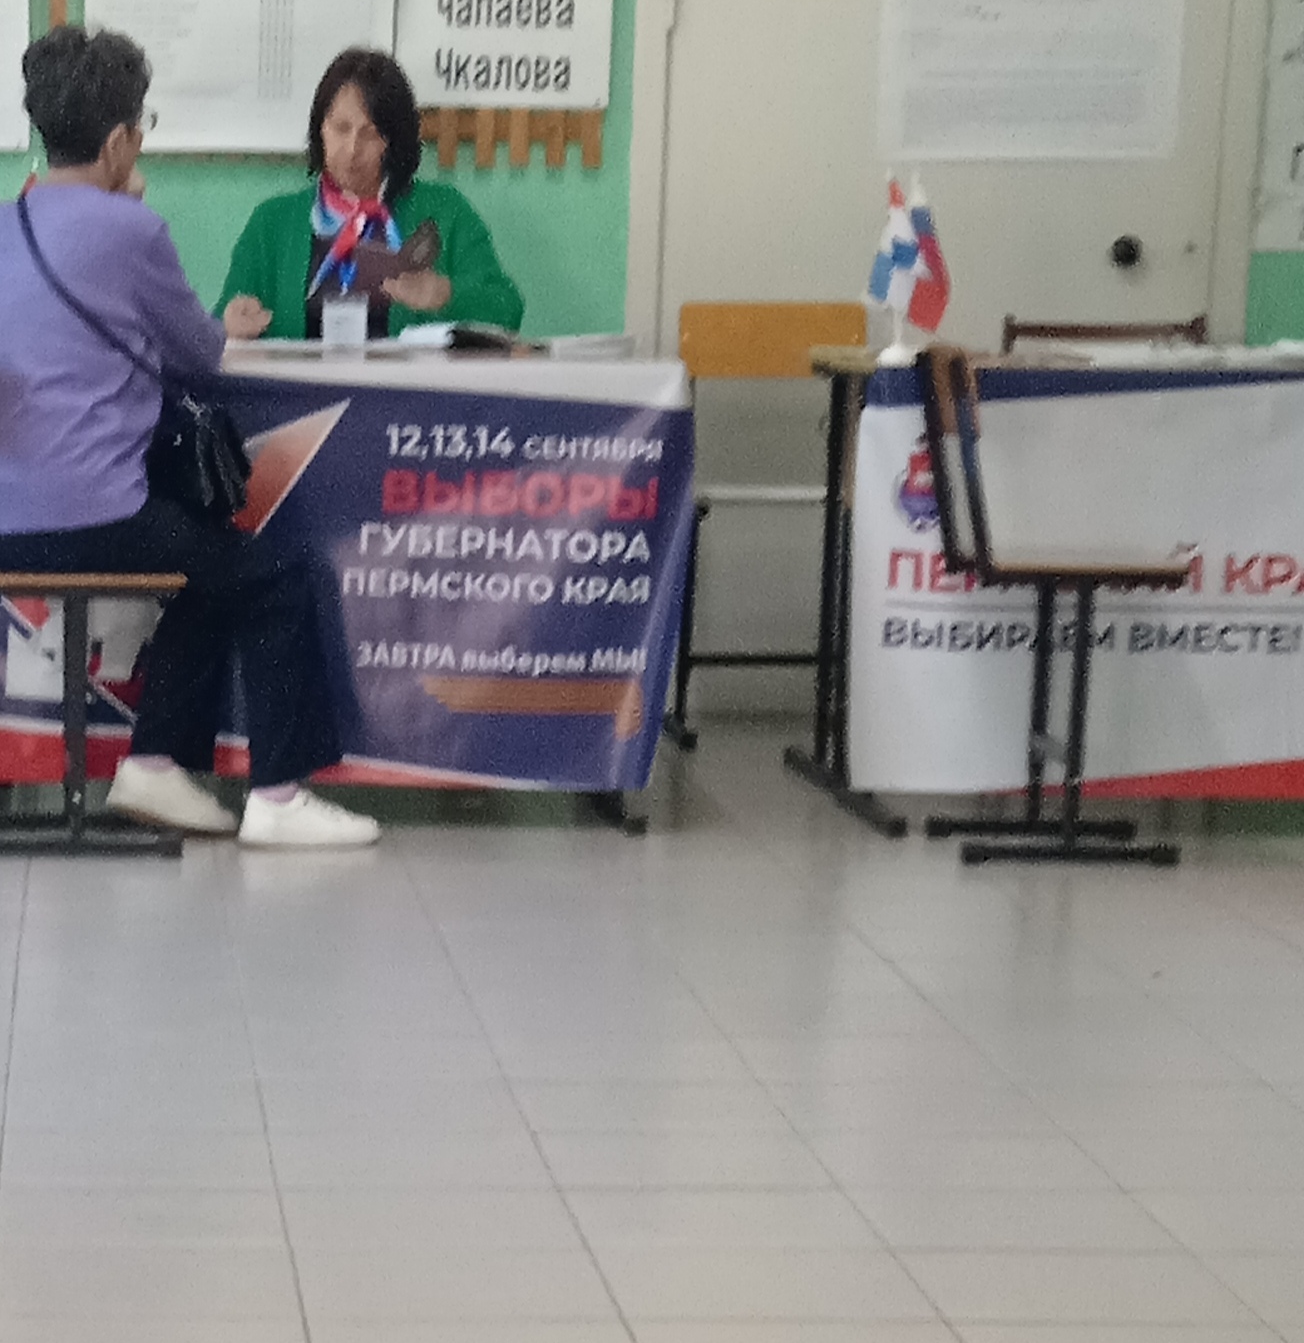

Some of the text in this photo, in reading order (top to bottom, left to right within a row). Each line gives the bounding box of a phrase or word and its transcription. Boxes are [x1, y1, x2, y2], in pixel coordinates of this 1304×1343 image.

[435, 48, 572, 92] Чкалова
[386, 423, 516, 460] 12,13,14
[381, 468, 660, 522] ВЫБОРЫ
[358, 521, 651, 565] ГУБЕРНАТОРА
[343, 566, 652, 605] ПЕРМСКОГО КРАЯ
[1222, 551, 1304, 596] КР
[356, 638, 456, 669] ЗАВТРА
[881, 615, 1116, 655] ВЫБИРЕМ
